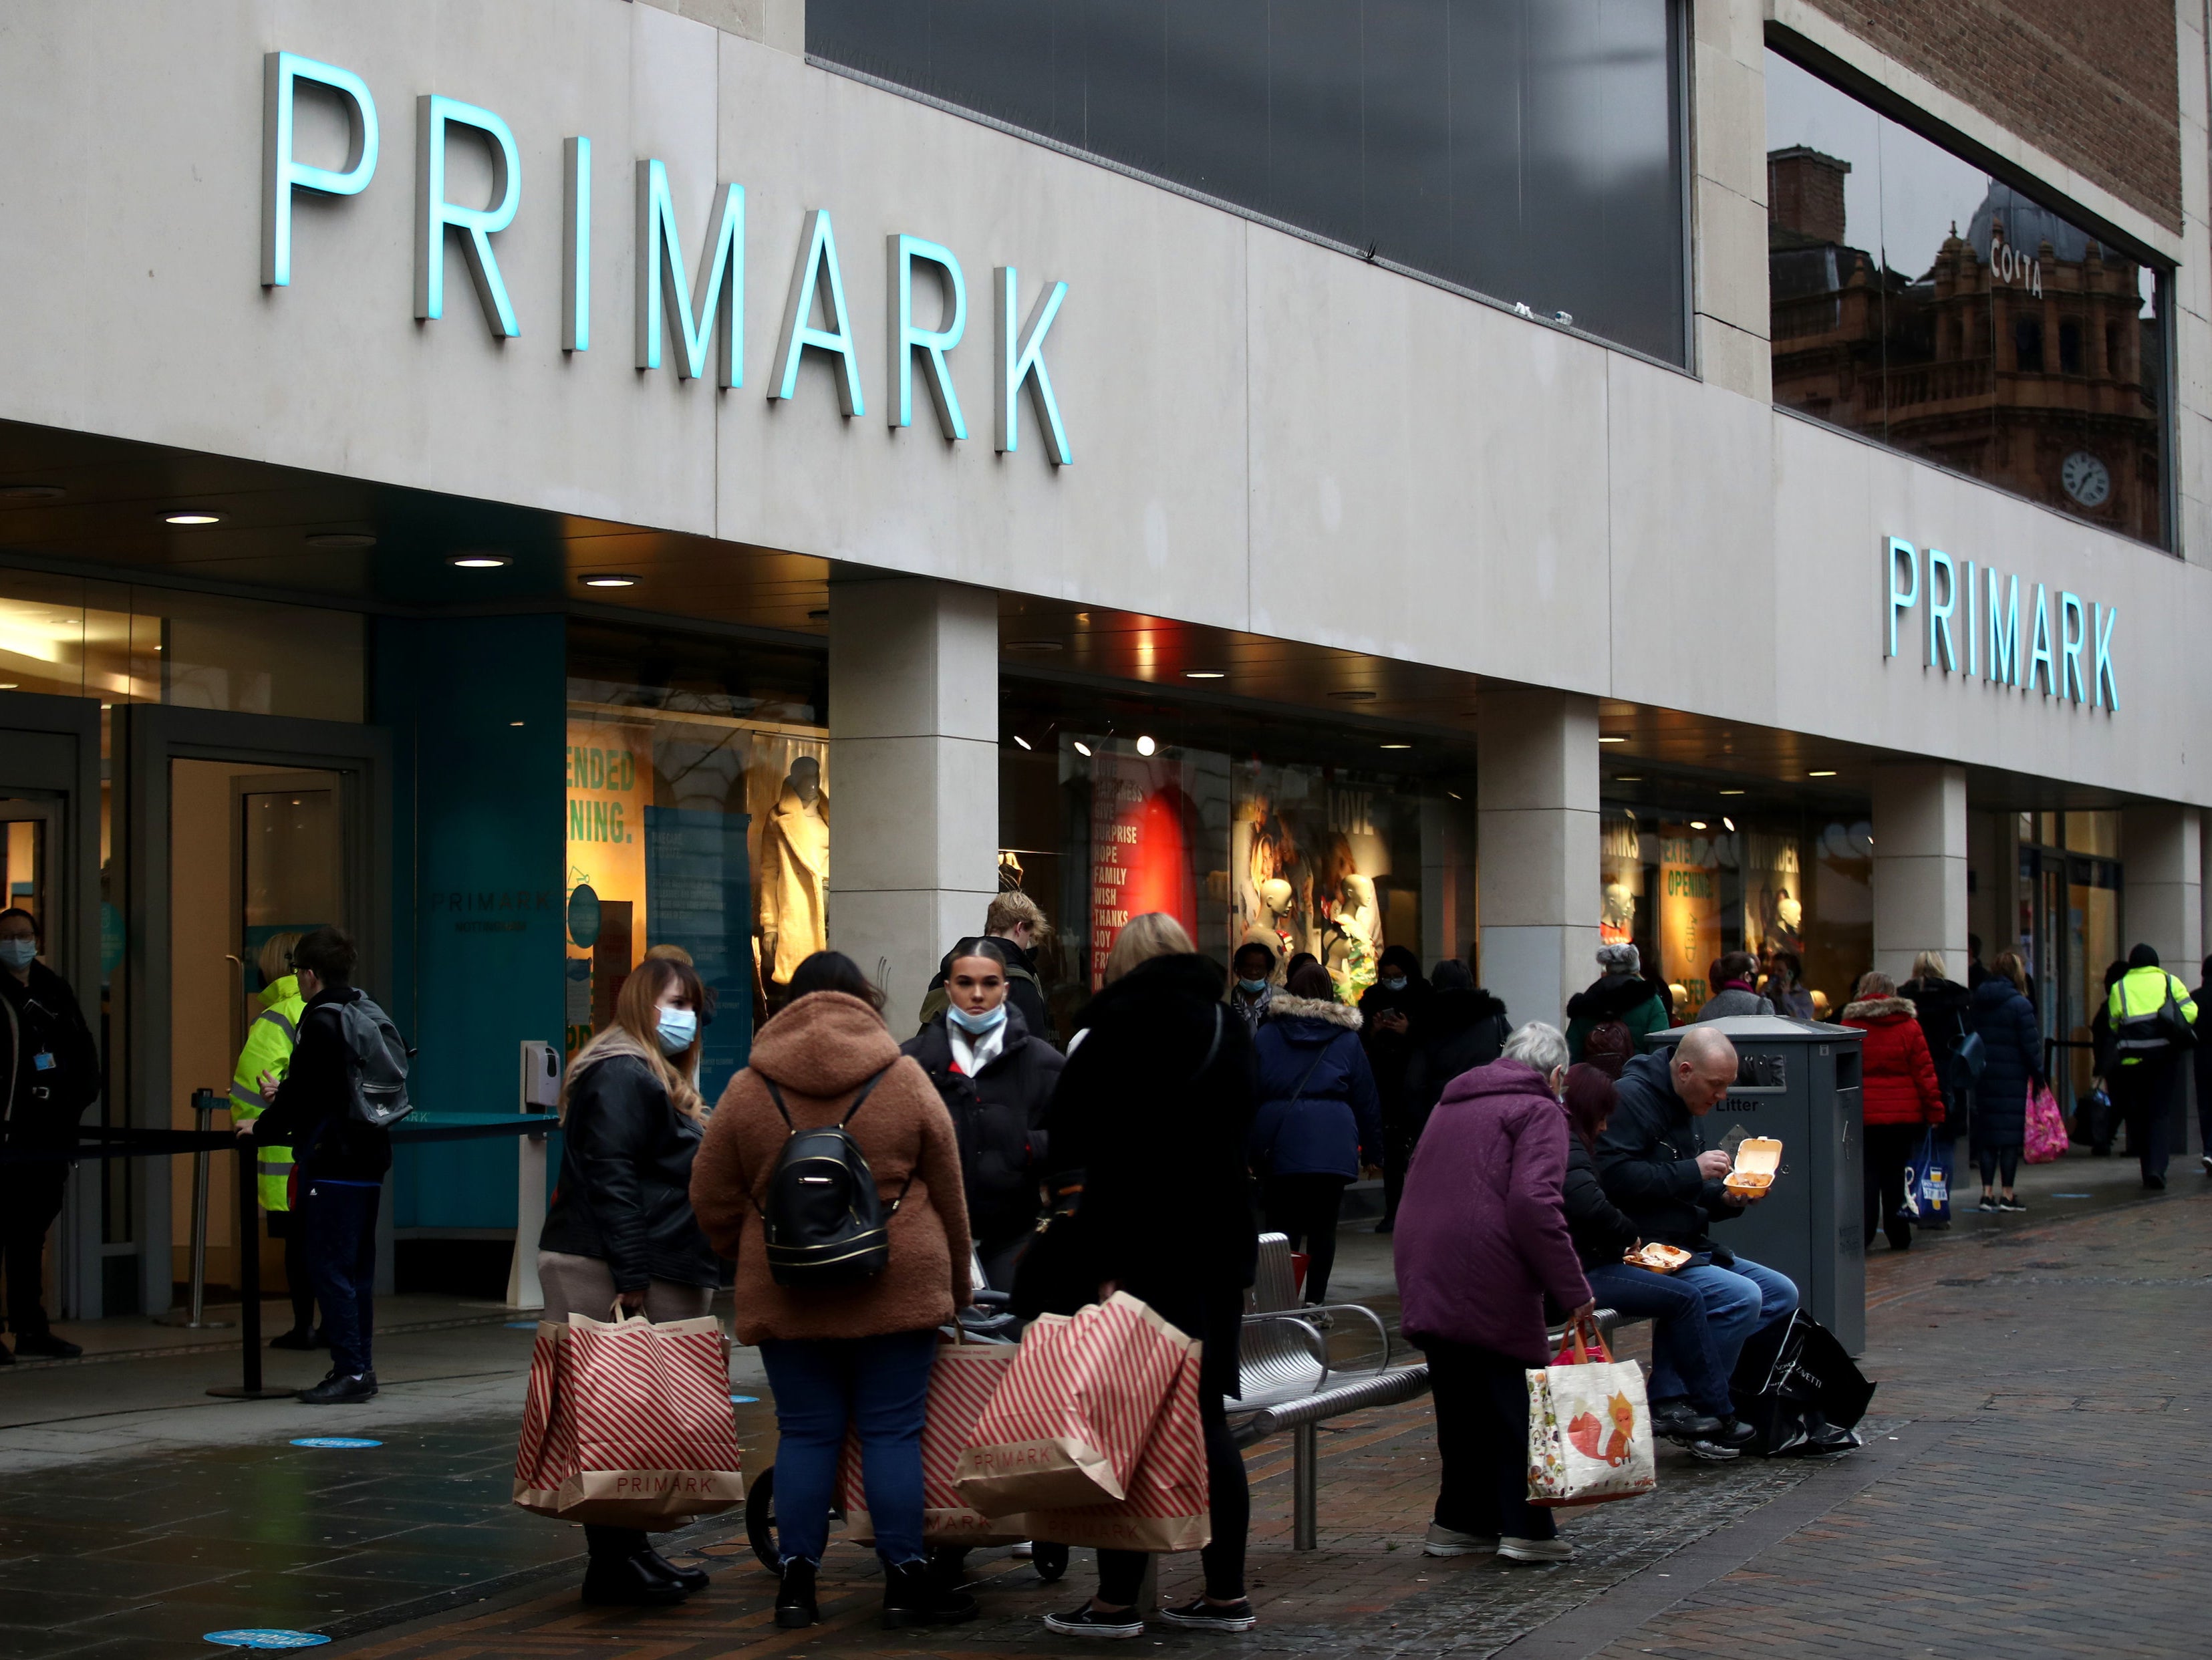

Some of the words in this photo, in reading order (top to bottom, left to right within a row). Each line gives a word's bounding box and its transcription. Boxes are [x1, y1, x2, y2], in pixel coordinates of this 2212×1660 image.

[261, 51, 1073, 464] PRIMARK
[1882, 535, 2120, 711] PRIMARK
[1095, 759, 1117, 778] LOVE
[1095, 779, 1143, 803] HAPPINESS
[1095, 802, 1115, 821] GIVE
[1327, 789, 1373, 835] LOVE
[1095, 823, 1137, 845] SURPRISE
[1095, 845, 1117, 863] HOPE
[1095, 865, 1127, 885] FAMILY
[432, 891, 551, 911] PRIMARK
[1095, 887, 1116, 906] WISH
[1095, 909, 1128, 927] THANKS
[1095, 930, 1111, 948] JOY
[1716, 1099, 1758, 1111] Litter
[974, 1446, 1051, 1470] PRIMARK
[616, 1478, 712, 1493] PRIMARK
[1048, 1520, 1139, 1540] PRIMARK
